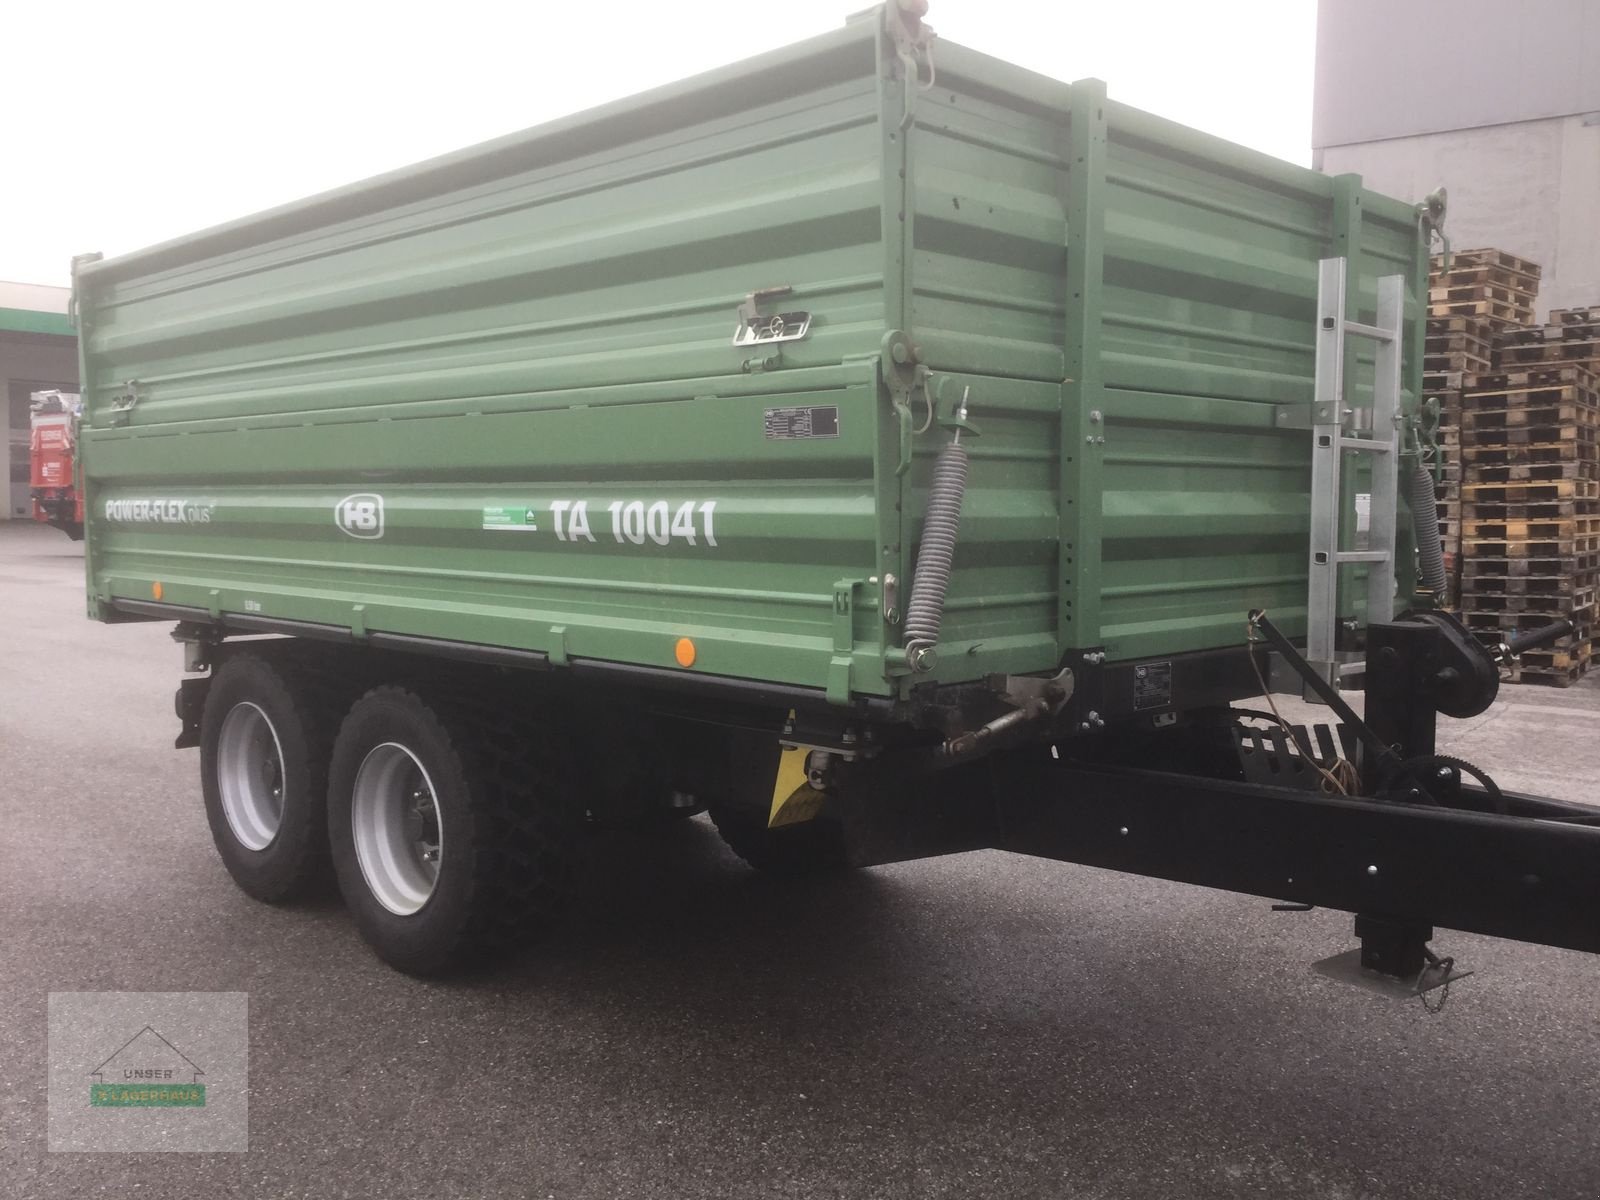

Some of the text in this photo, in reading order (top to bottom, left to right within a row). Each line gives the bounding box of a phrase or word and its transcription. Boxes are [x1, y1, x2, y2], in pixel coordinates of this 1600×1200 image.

[105, 499, 188, 524] POWER-FLEX
[550, 500, 718, 547] TA 10041
